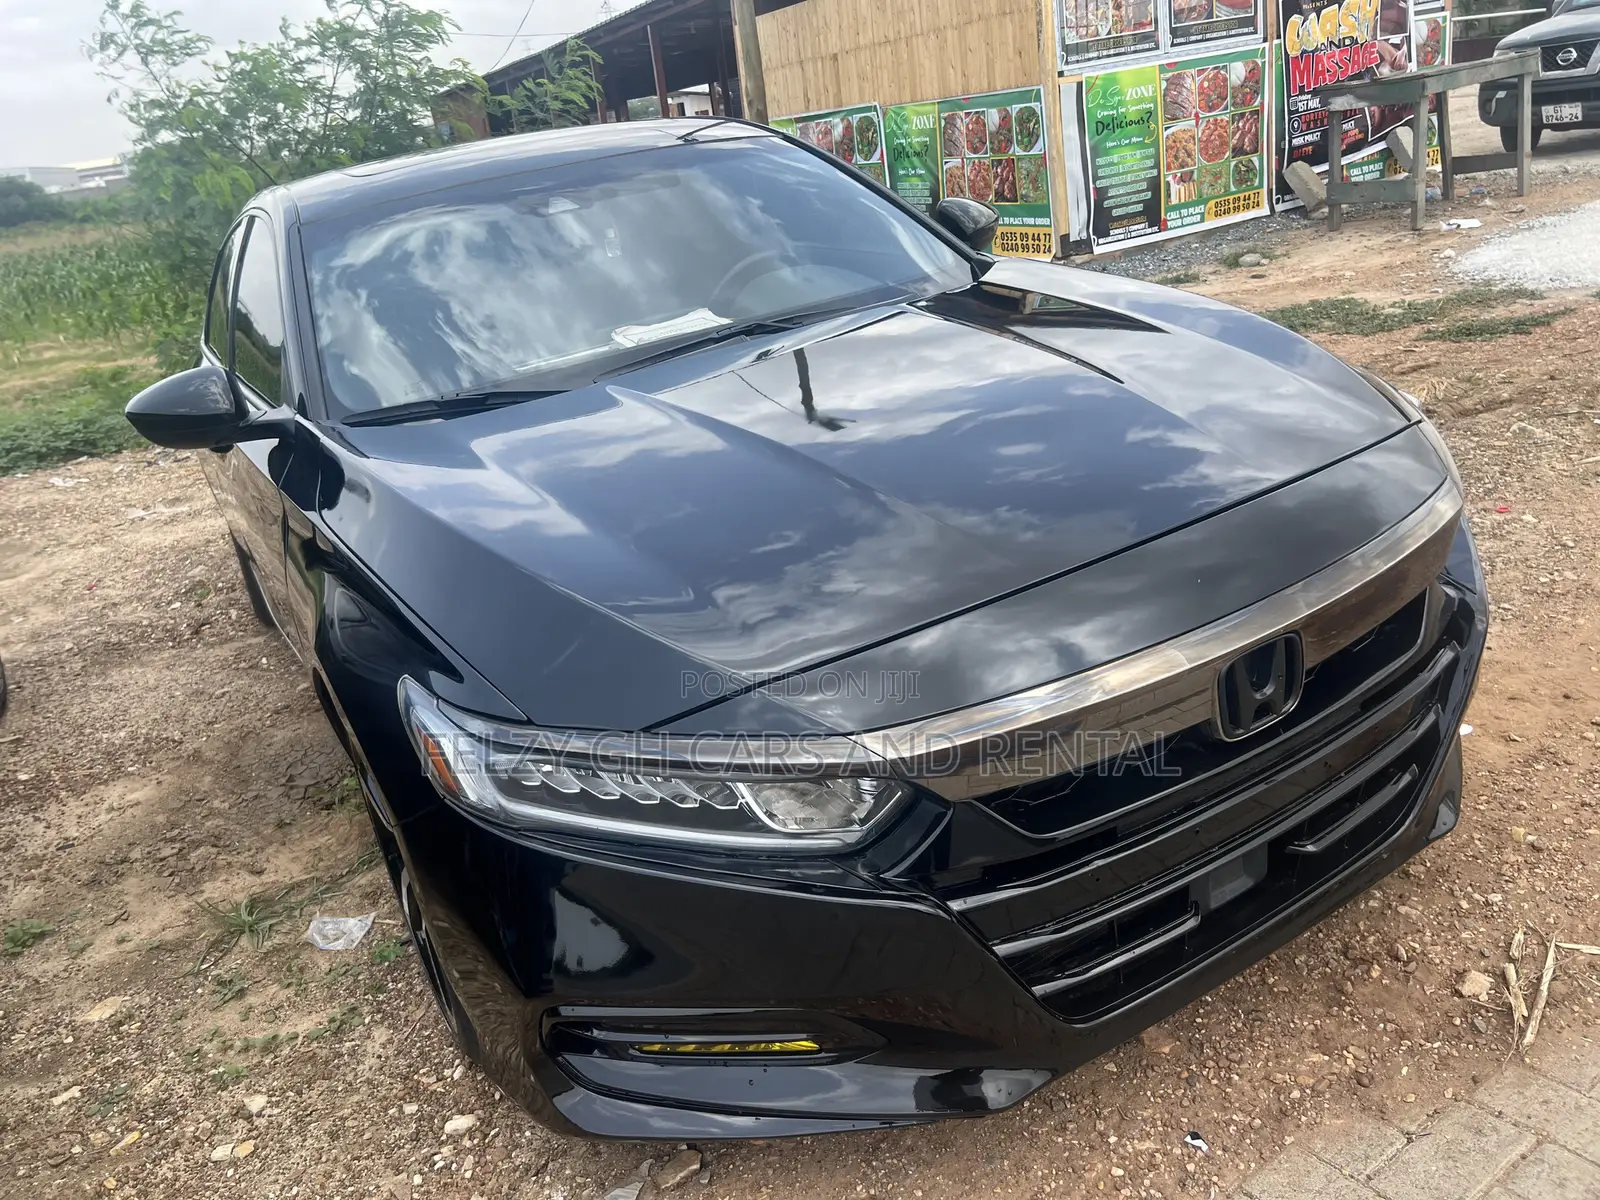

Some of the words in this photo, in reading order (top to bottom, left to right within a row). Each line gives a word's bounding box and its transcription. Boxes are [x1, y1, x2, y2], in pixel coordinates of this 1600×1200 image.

[1286, 0, 1377, 57] WASH
[1320, 36, 1355, 51] AND
[1290, 41, 1380, 96] MASSAGE
[1125, 84, 1157, 100] ZONE
[1553, 106, 1563, 114] GT
[911, 114, 936, 130] ZONE
[1095, 111, 1153, 136] Delicious?
[1350, 167, 1362, 176] CALL
[1362, 165, 1369, 173] TO
[1369, 162, 1384, 172] PLACE
[1364, 171, 1380, 181] ORDER
[1214, 198, 1231, 209] 0535
[1232, 196, 1241, 206] 09
[1242, 193, 1251, 204] 44
[1252, 191, 1260, 201] 77
[1166, 210, 1180, 220] CALL
[1180, 208, 1188, 217] TO
[1188, 204, 1205, 215] PLACE
[1214, 206, 1231, 218] 0240
[1232, 204, 1241, 214] 99
[1242, 201, 1251, 211] 50
[1251, 199, 1260, 210] 24
[1009, 217, 1022, 225] PLACE
[1167, 218, 1182, 229] YOUR
[1182, 214, 1201, 224] ORDER
[1000, 231, 1018, 242] 0535
[1019, 232, 1029, 242] 09
[1031, 232, 1041, 243] 44
[1042, 233, 1052, 243] 77
[1001, 242, 1019, 252] 0240
[1020, 243, 1030, 253] 99
[1031, 243, 1041, 254] 50
[1042, 244, 1052, 254] 24
